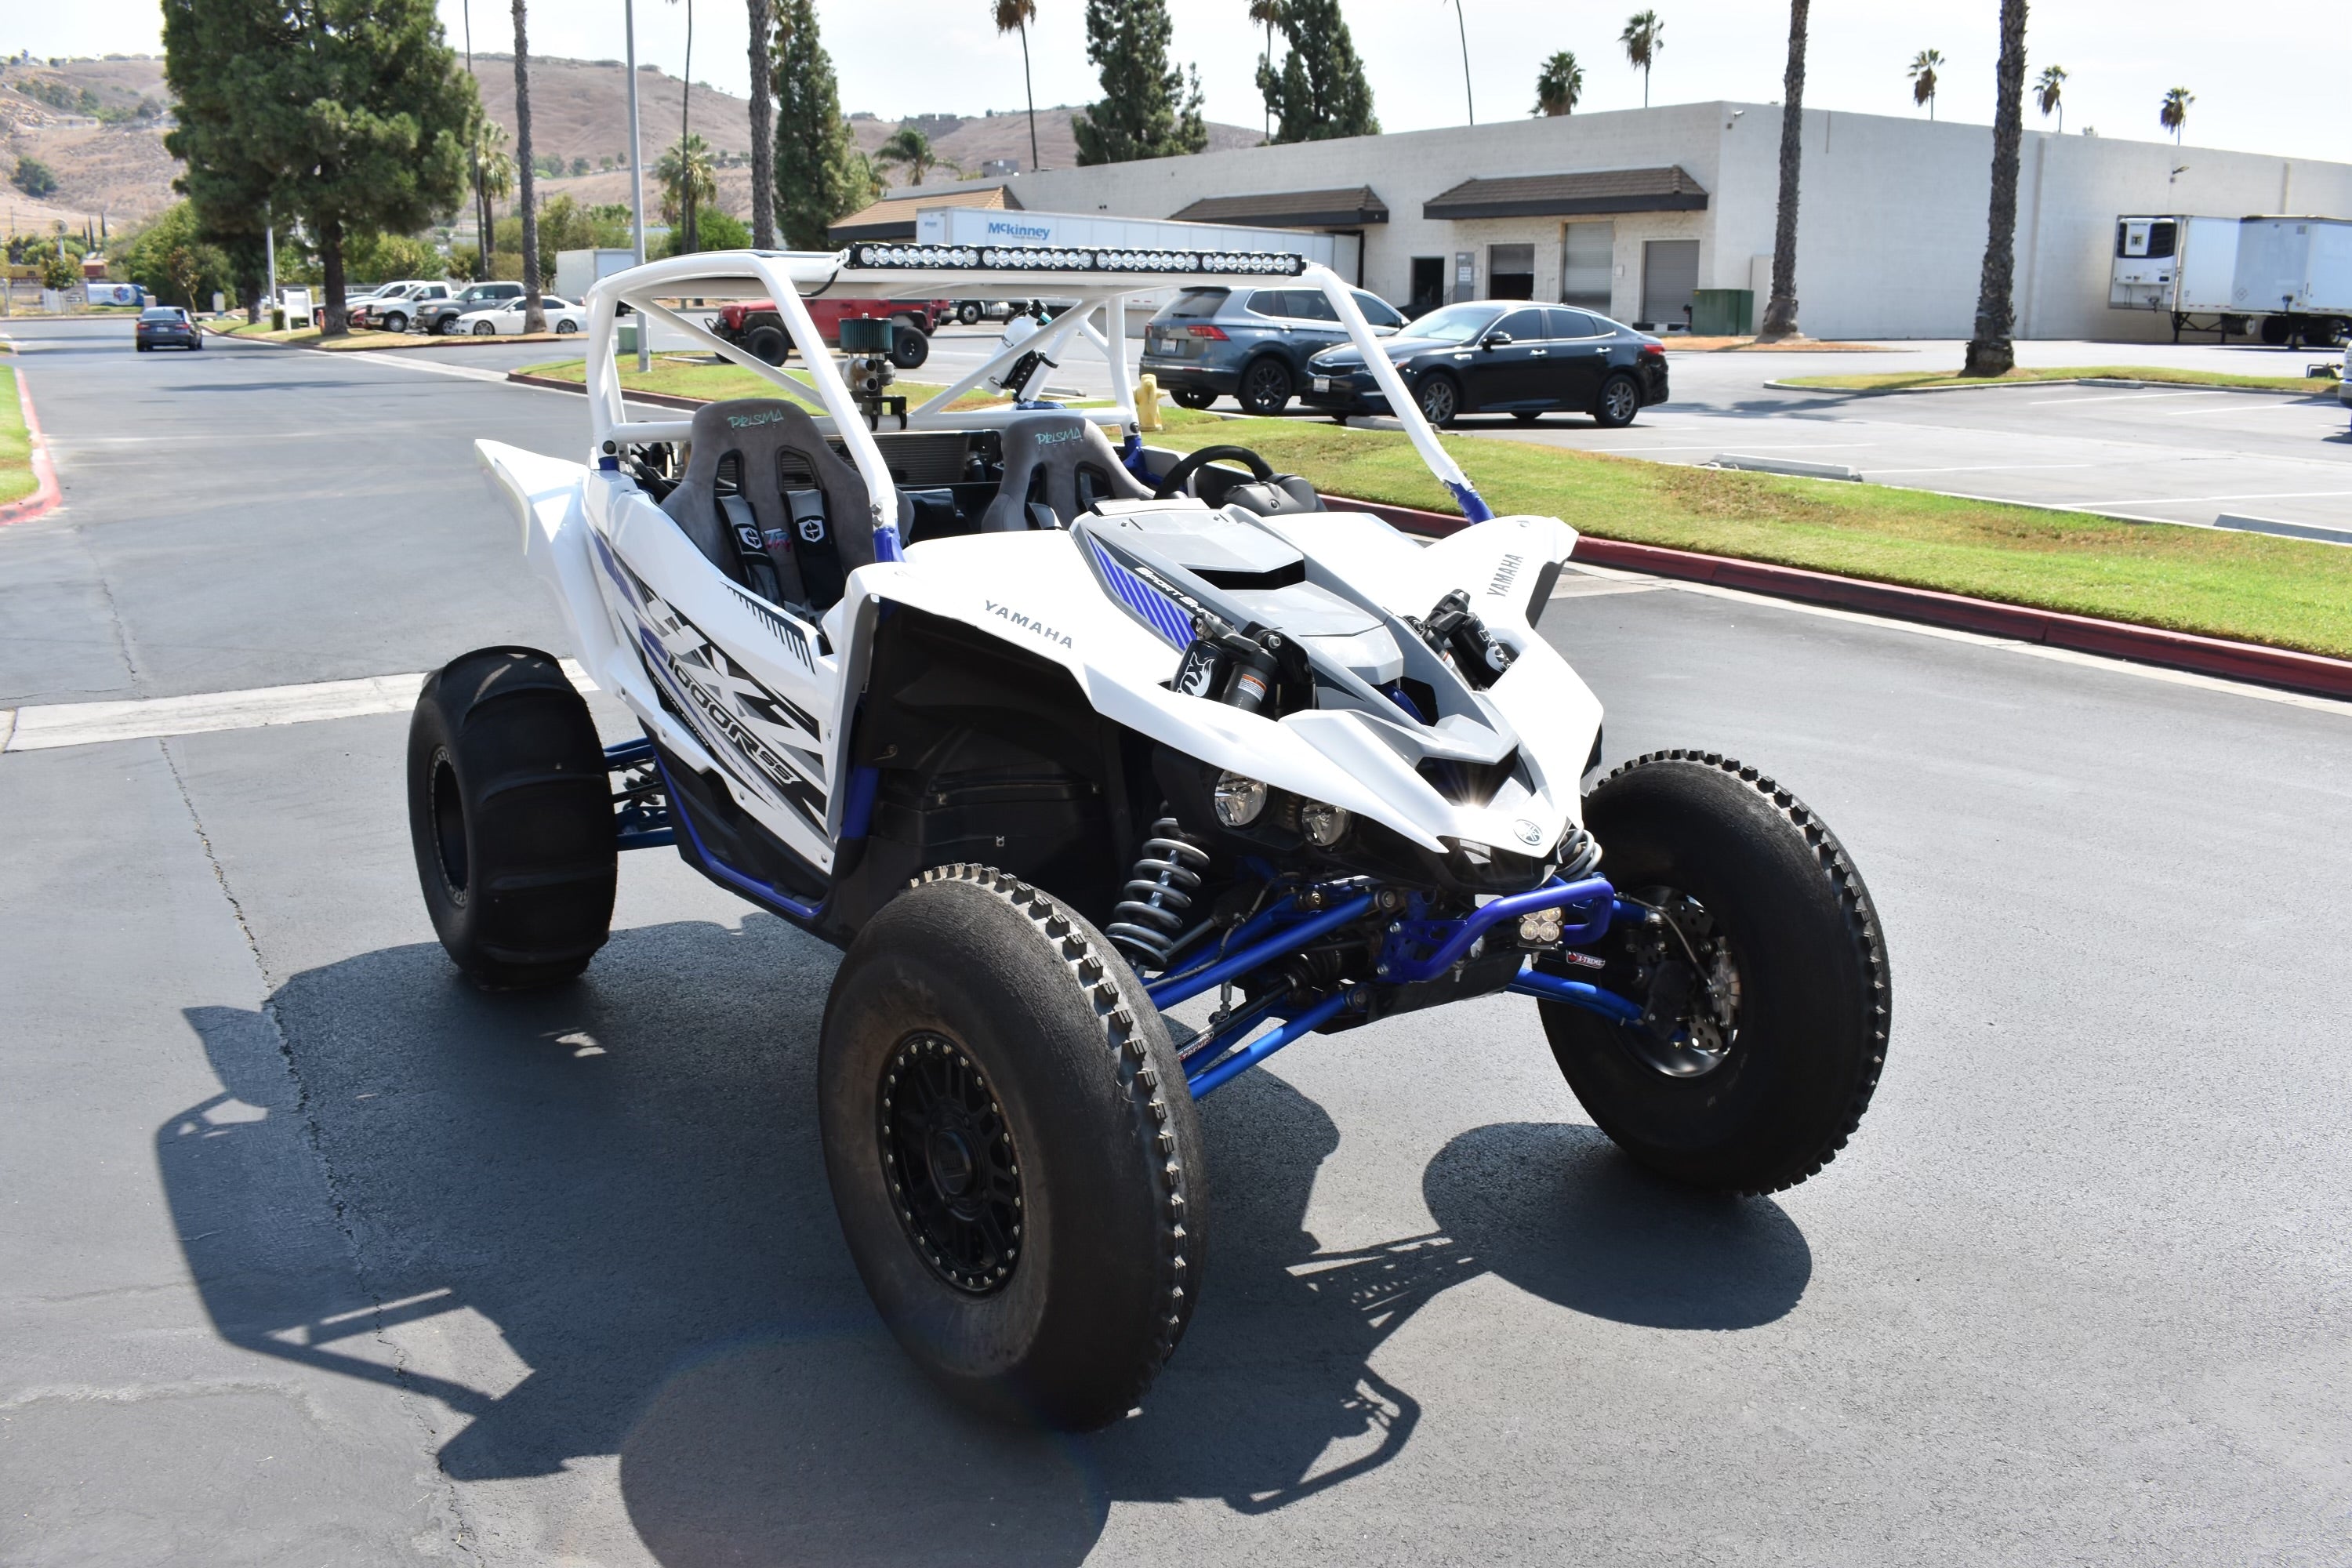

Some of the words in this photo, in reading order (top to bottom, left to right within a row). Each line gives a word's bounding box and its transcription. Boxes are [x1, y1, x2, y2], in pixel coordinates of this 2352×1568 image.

[1486, 554, 1523, 597] YAMAHA
[985, 599, 1073, 649] YAMAHA
[1178, 652, 1211, 697] OX
